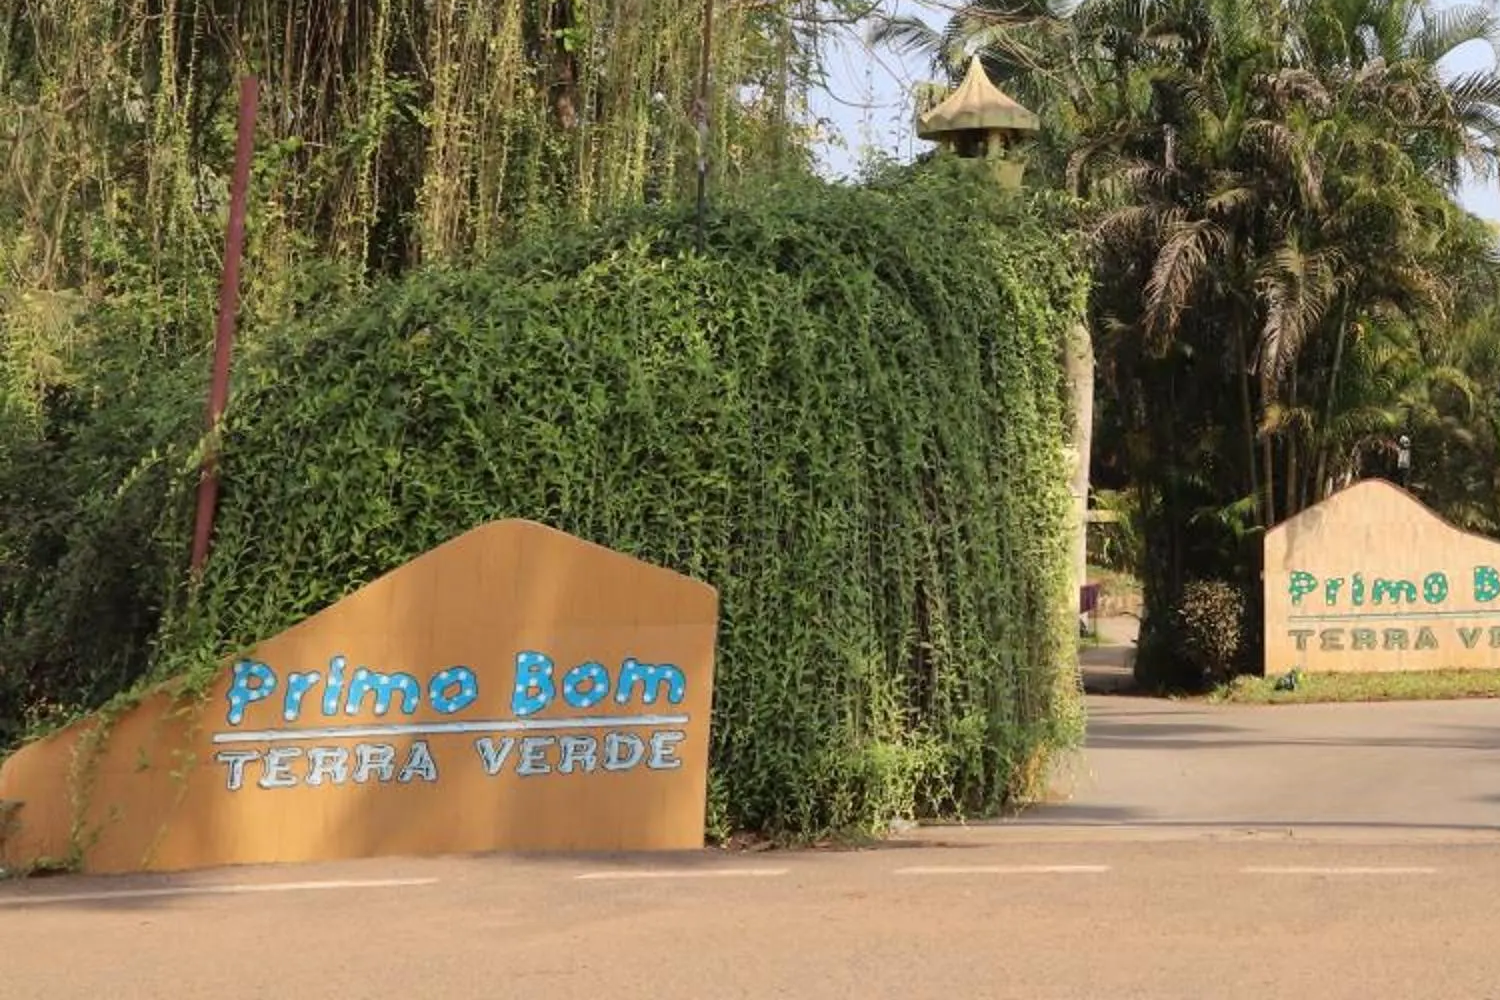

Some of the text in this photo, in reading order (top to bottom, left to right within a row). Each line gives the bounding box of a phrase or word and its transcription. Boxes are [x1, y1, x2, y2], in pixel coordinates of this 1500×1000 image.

[1288, 570, 1449, 606] Primo
[1287, 627, 1439, 651] TERRA
[226, 650, 686, 725] Primo Bom
[216, 730, 685, 791] TERRA VERDE
